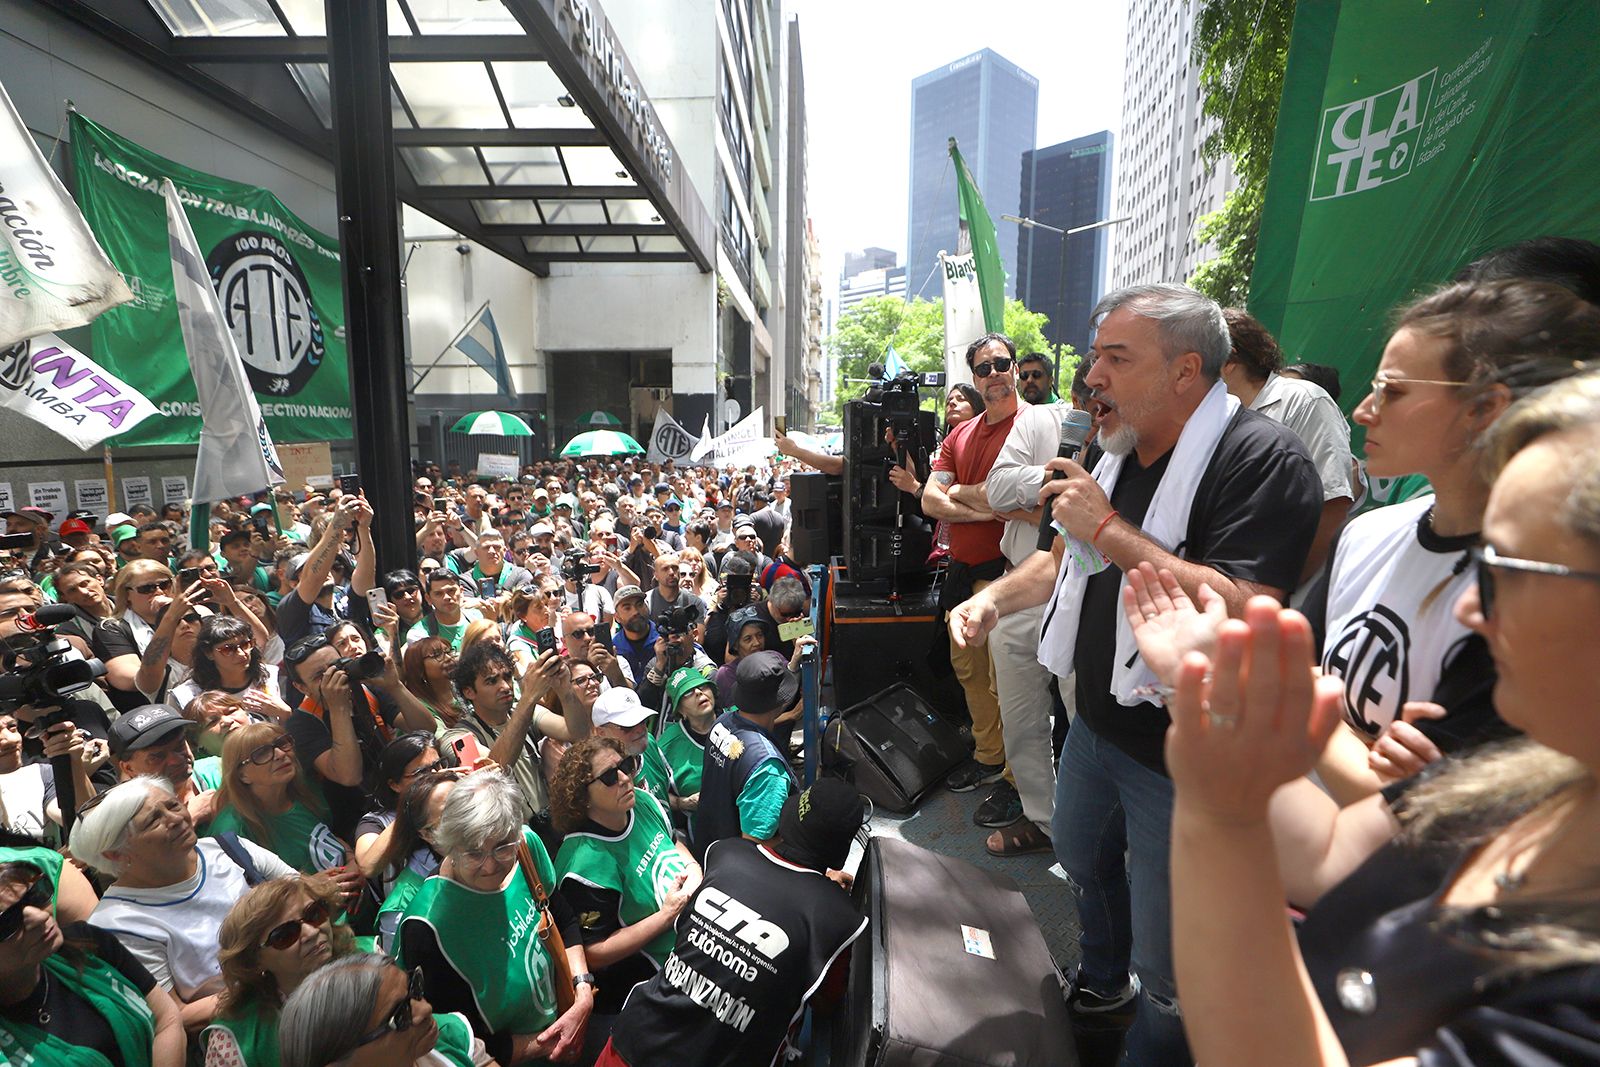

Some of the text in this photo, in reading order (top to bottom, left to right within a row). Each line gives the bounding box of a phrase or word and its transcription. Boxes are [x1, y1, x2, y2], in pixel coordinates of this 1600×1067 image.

[235, 237, 260, 252] 100
[225, 263, 302, 362] ATE
[24, 380, 87, 426] AMBA
[31, 347, 136, 429] INTA
[258, 403, 308, 418] ECTIVO
[658, 425, 689, 456] ATE
[694, 886, 790, 960] CTA
[687, 928, 758, 983] autónoma
[751, 953, 778, 975] argentina
